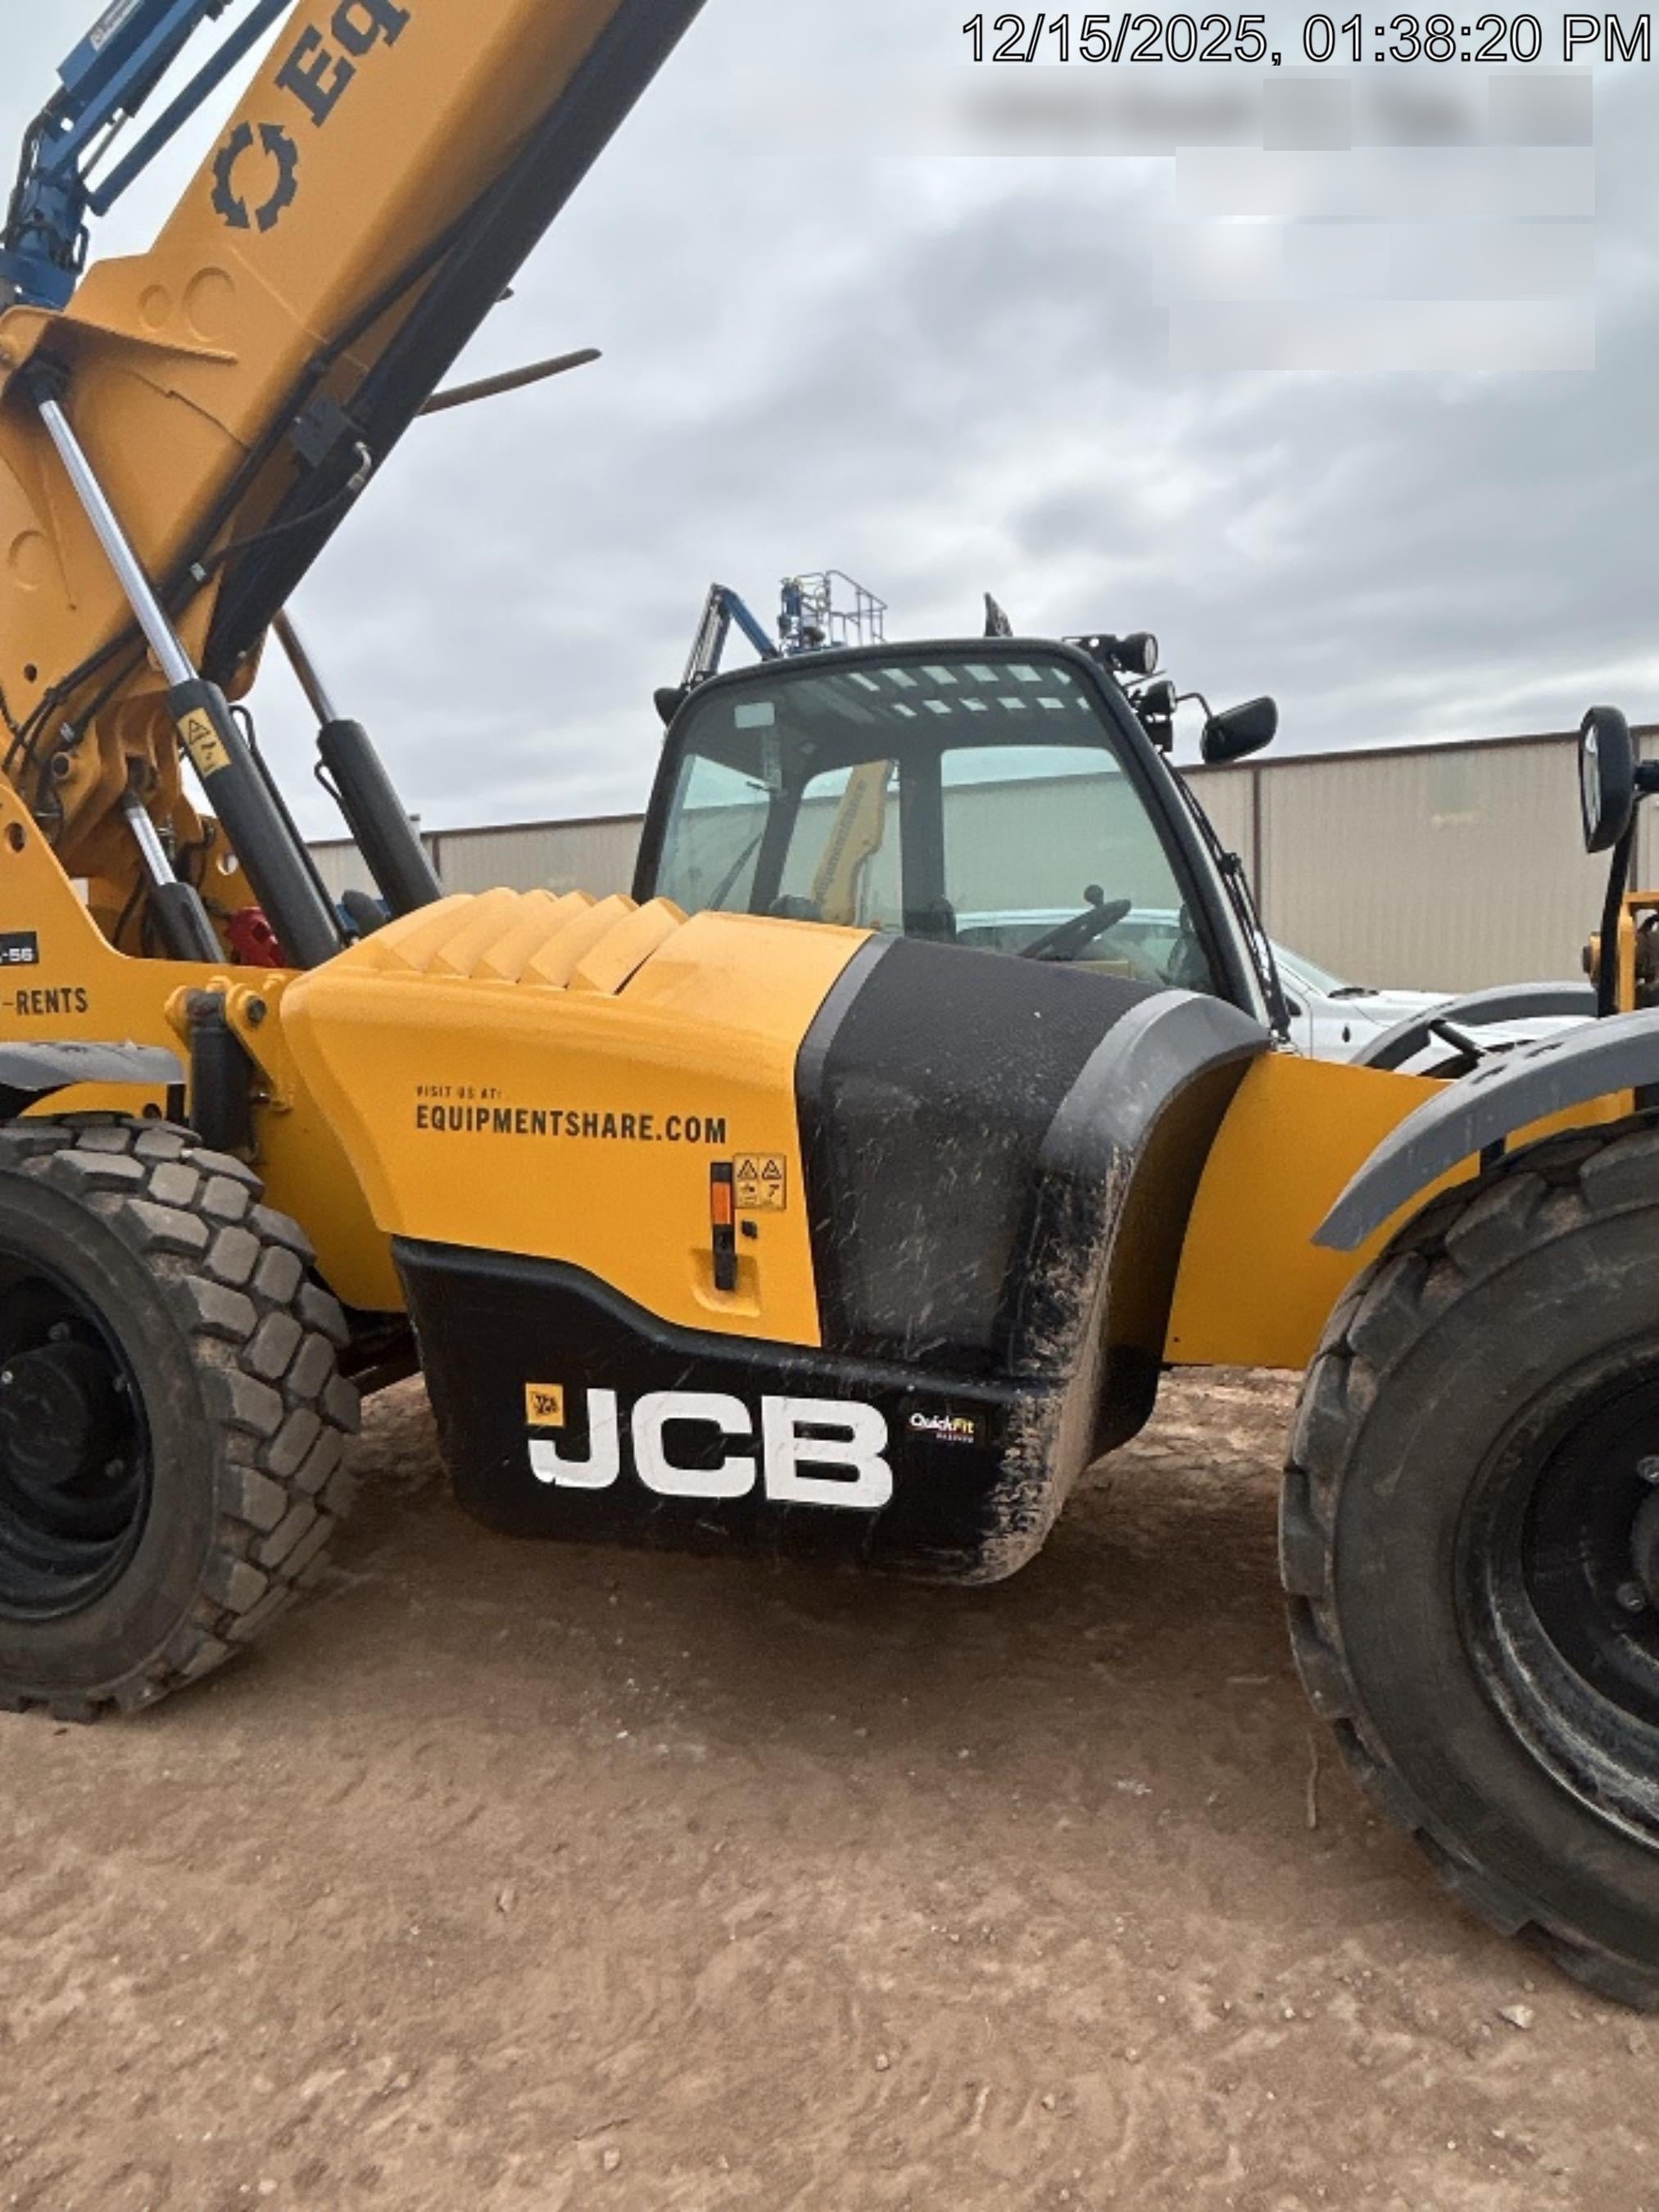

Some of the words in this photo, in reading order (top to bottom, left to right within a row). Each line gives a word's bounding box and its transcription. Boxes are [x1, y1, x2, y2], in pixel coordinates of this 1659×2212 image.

[416, 1086, 452, 1098] VISIT
[458, 1086, 474, 1099] US
[416, 1104, 728, 1145] EQUIPMENTSHARE.COM
[528, 1387, 894, 1509] JCB
